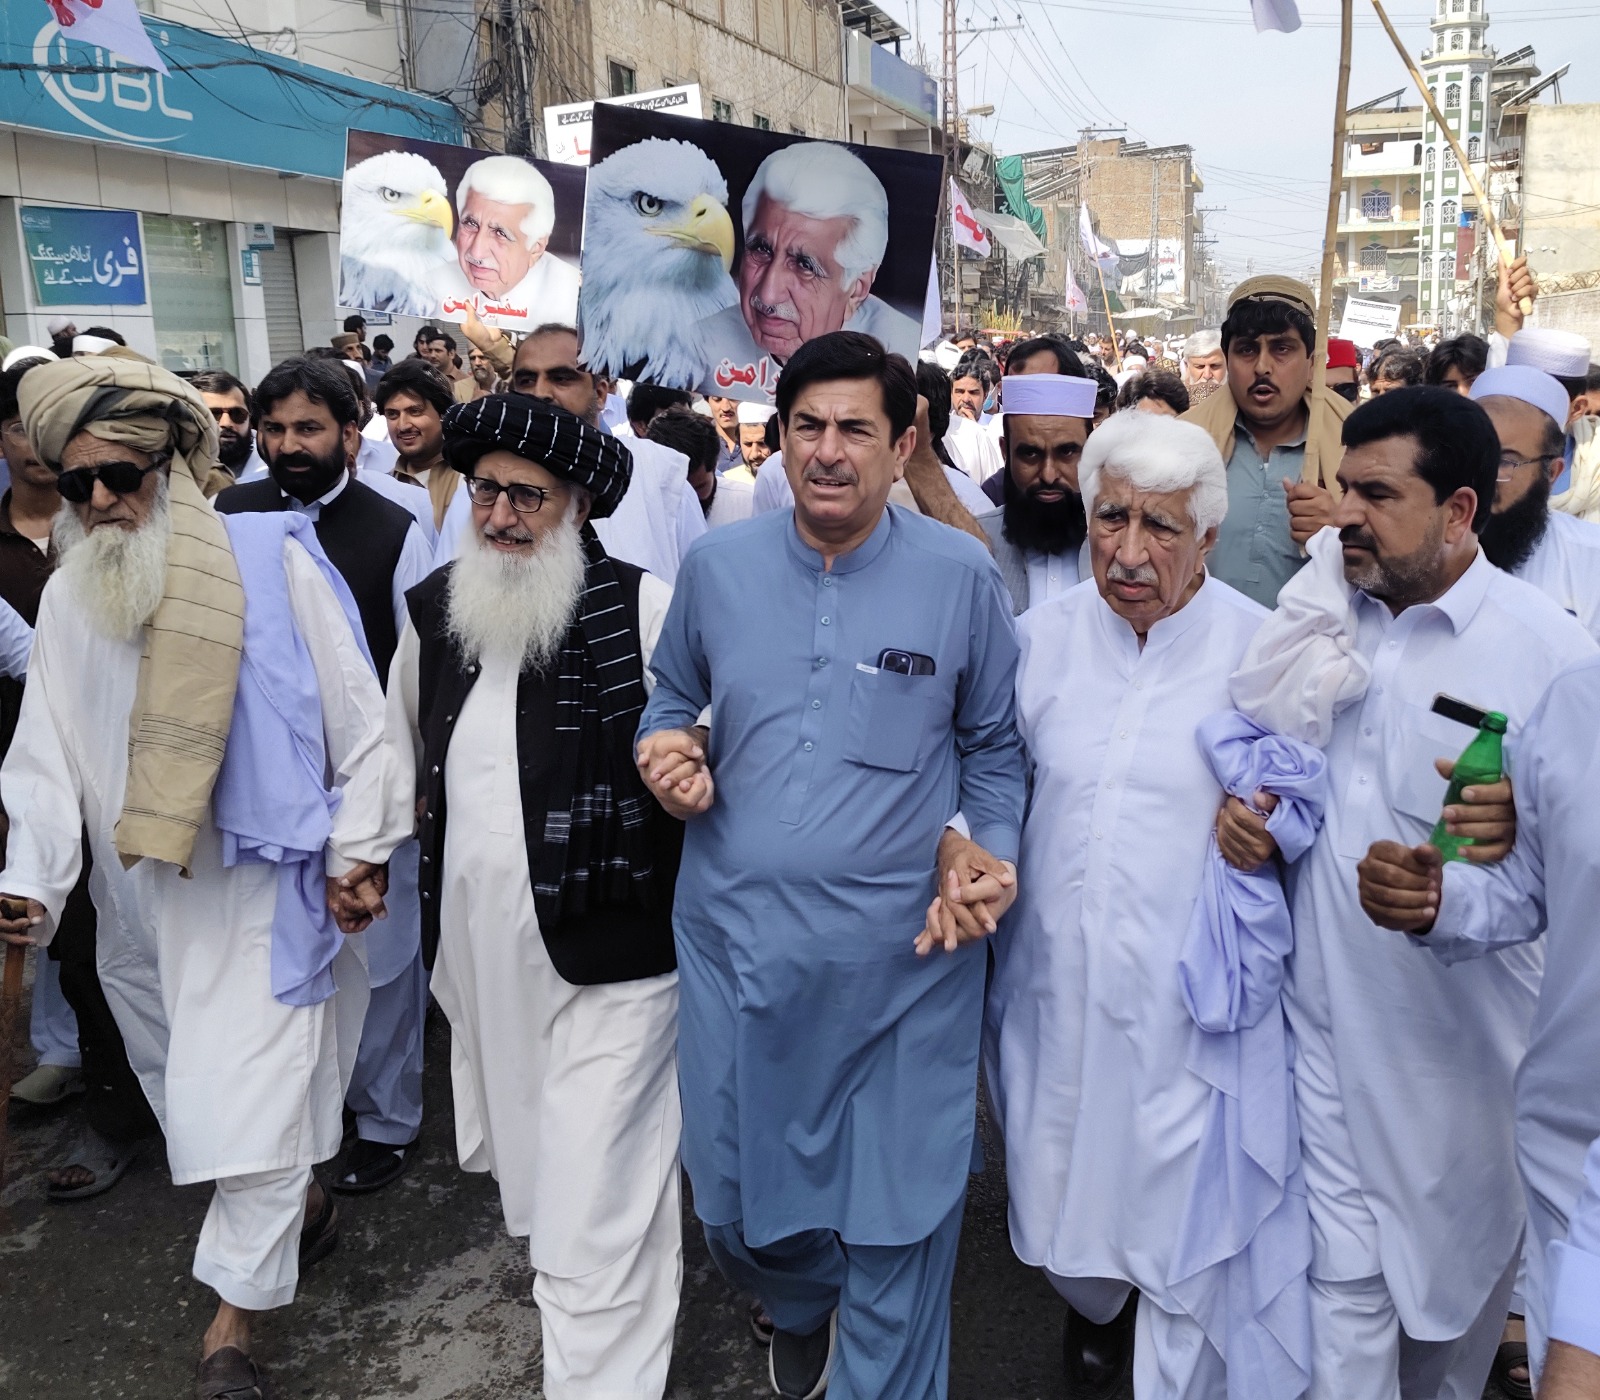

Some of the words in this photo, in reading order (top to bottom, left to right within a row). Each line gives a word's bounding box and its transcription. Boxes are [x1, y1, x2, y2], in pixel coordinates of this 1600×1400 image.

[58, 36, 193, 121] UBL
[93, 236, 139, 287] فری
[443, 295, 478, 313] ان
[478, 298, 528, 318] سفیر
[716, 359, 767, 387] امن
